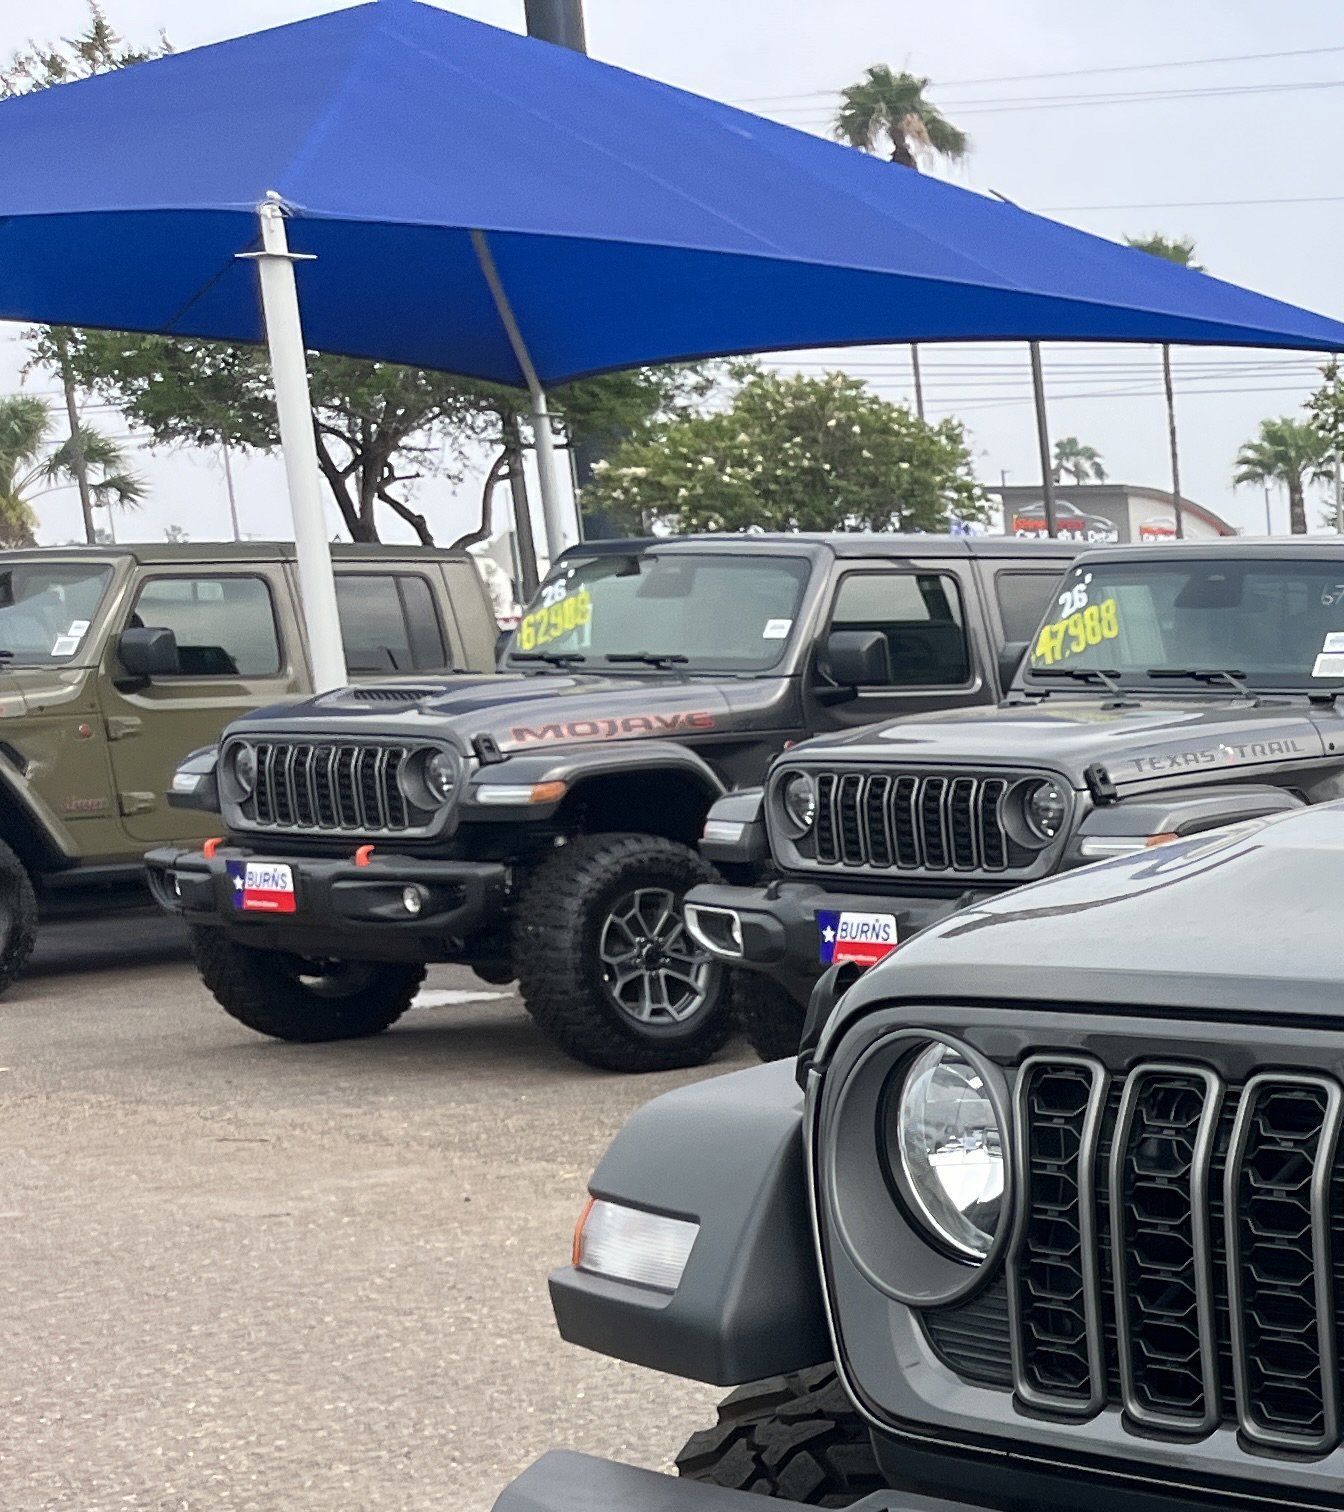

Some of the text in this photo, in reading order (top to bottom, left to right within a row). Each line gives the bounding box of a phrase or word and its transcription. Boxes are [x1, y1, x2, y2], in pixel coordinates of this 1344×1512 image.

[511, 711, 716, 743] MOJAVE
[1128, 738, 1305, 773] TEXAS TRAIL
[247, 871, 288, 890] BURNS
[839, 921, 891, 942] BURNS
